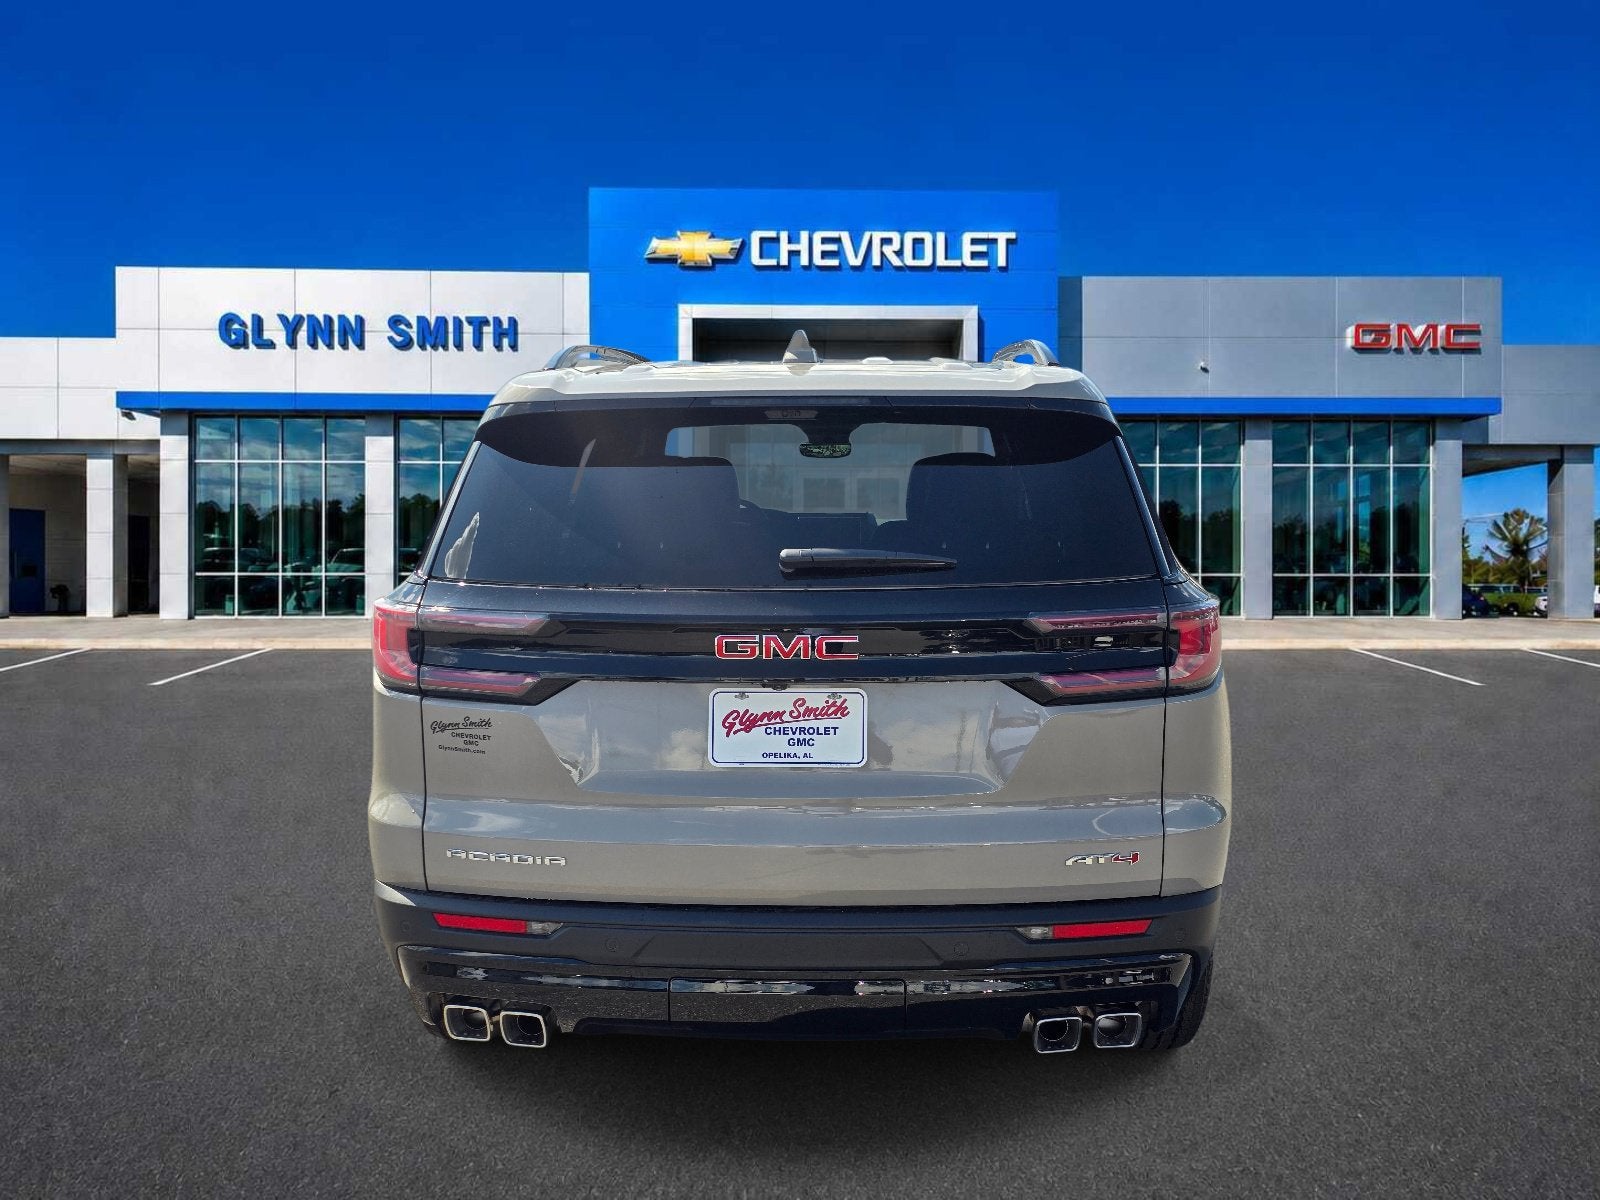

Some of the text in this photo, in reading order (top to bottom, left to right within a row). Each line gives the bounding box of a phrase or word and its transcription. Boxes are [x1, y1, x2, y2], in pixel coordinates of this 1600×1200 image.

[750, 230, 1017, 271] CHEVROLET
[218, 312, 519, 352] GLYNN SMITH
[1347, 323, 1482, 355] GMC
[714, 634, 859, 661] GMC
[430, 716, 493, 734] Glynn Smith
[721, 697, 850, 738] Glynn Smith
[451, 731, 492, 741] CHEVROLET
[764, 726, 839, 736] CHEVROLET
[463, 739, 479, 747] GMC
[787, 737, 815, 747] GMC
[761, 752, 801, 760] OPELIKA,
[446, 848, 567, 866] ACADIA
[1065, 851, 1140, 866] AT4
